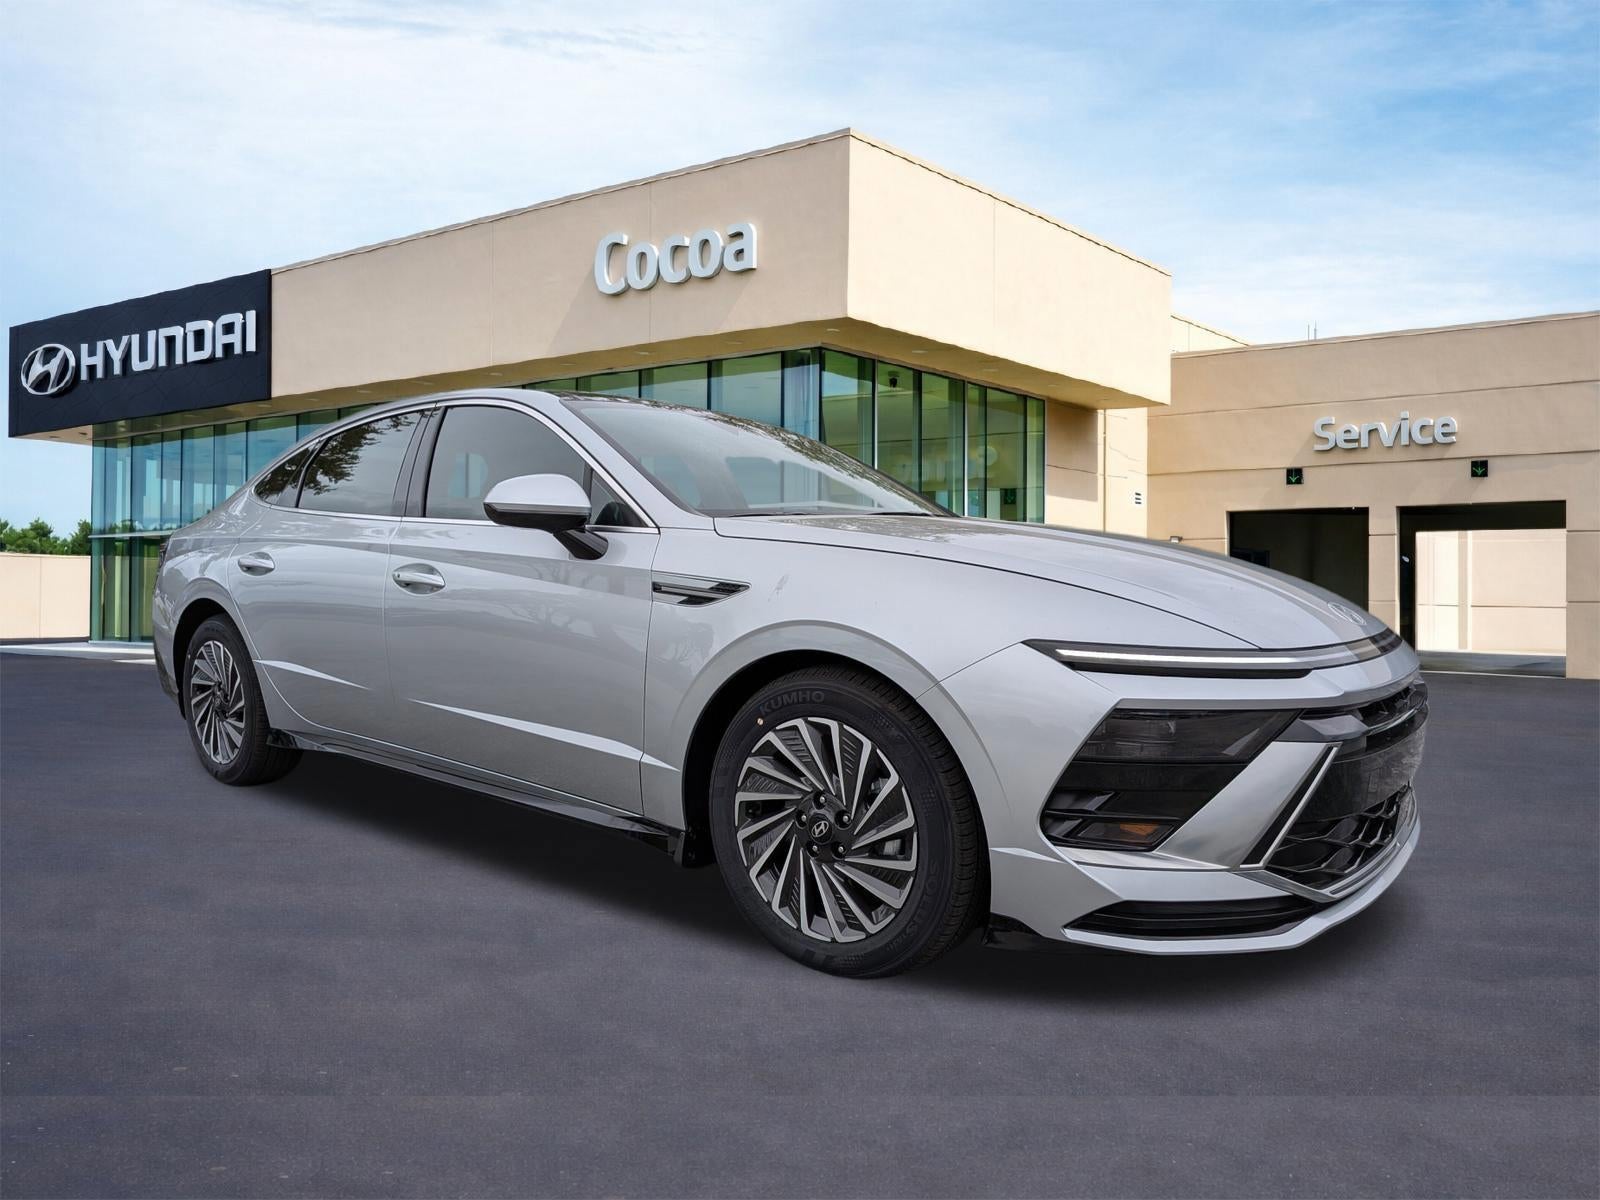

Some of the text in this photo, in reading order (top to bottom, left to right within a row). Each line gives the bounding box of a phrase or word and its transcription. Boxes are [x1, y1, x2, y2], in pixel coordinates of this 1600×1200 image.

[594, 222, 758, 295] Cocoa
[80, 309, 256, 381] HYUNDAI
[1313, 411, 1458, 451] Service
[760, 690, 825, 715] KUMHO
